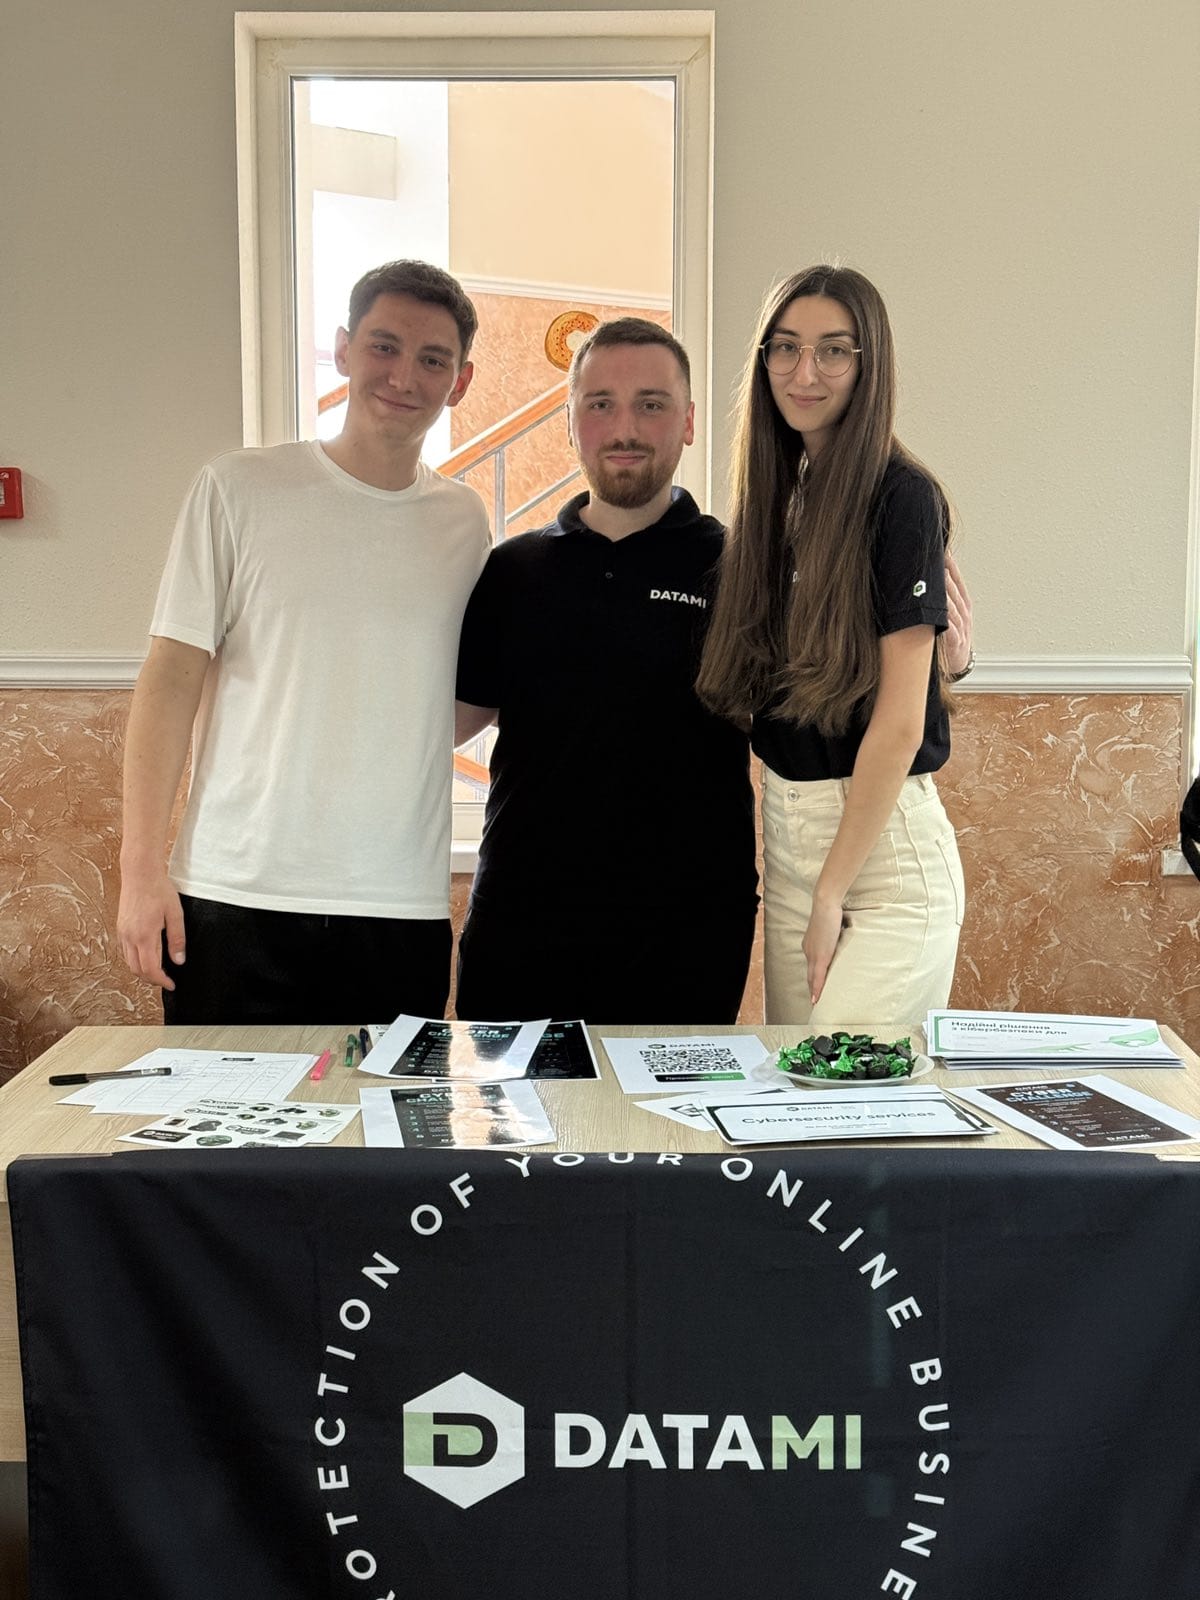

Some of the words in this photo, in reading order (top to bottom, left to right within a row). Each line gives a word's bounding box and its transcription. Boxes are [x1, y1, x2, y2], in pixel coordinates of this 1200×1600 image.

[650, 589, 707, 609] DATAMI
[1010, 1088, 1072, 1097] CYBER
[742, 1114, 862, 1124] Cybersecurity
[866, 1111, 936, 1119] services
[315, 1252, 400, 1600] OTECTION
[411, 1173, 475, 1236] OF
[505, 1152, 684, 1179] YOUR
[721, 1158, 923, 1329] ONLINE
[554, 1412, 862, 1471] DATAMI
